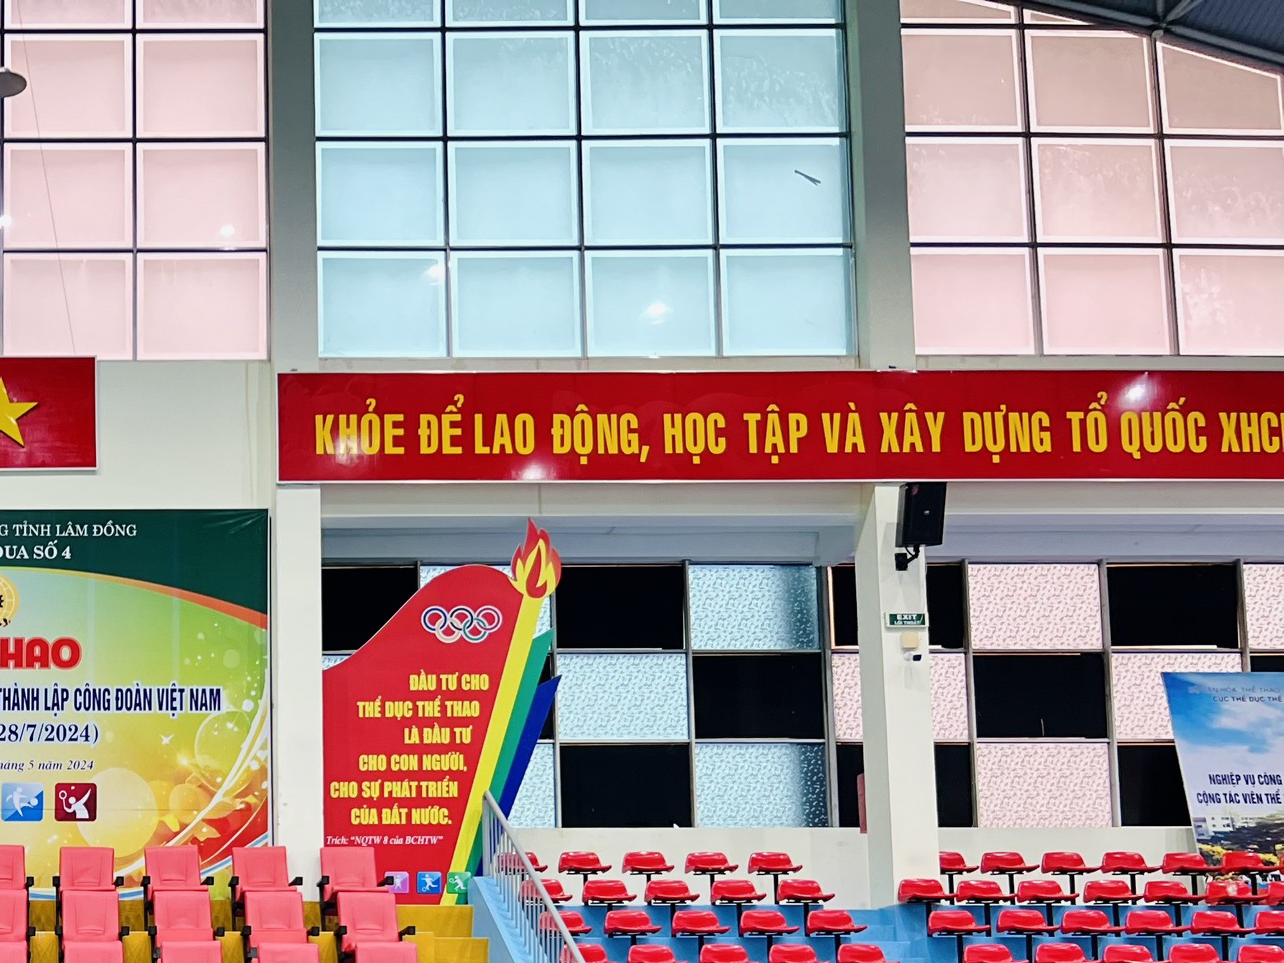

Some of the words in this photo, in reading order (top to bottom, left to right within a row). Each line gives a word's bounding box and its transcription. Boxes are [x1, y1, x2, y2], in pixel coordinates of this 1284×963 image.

[315, 398, 404, 455] KHỎE
[419, 394, 464, 454] ĐỂ
[475, 414, 535, 455] LAO
[552, 404, 649, 464] ĐỘNG,
[664, 413, 726, 464] HỌC
[744, 405, 808, 464] TẬP
[822, 403, 865, 453] VÀ
[881, 404, 945, 452] XÂY
[963, 405, 1051, 463] DỰNG
[1067, 392, 1107, 452] TỔ
[1121, 398, 1207, 458] QUỐC
[1220, 412, 1284, 452] XHC
[13, 521, 51, 536] TỈNH
[56, 522, 88, 536] LÂM
[93, 520, 136, 536] ĐỒNG
[34, 540, 57, 559] SỐ
[62, 546, 71, 559] 4
[410, 670, 436, 690] ĐẦU
[440, 672, 458, 690] TƯ
[462, 674, 489, 690] CHO
[45, 681, 69, 716] LẬP
[74, 681, 110, 711] CÔNG
[115, 681, 152, 711] ĐOÀN
[157, 681, 185, 716] VIỆT
[190, 689, 220, 711] NAM
[357, 696, 381, 717] THỂ
[385, 701, 412, 720] DỤC
[416, 696, 441, 717] THỂ
[445, 701, 480, 717] THAO
[404, 726, 420, 744] LÀ
[423, 723, 450, 744] ĐẦU
[454, 725, 472, 744] TƯ
[28, 759, 34, 770] 5
[38, 761, 63, 770] năm
[67, 759, 94, 770] 2024
[359, 755, 386, 771] CHO
[391, 754, 418, 771] CON
[423, 752, 467, 771] NGƯỜI,
[330, 782, 358, 798] CHO
[362, 779, 381, 800] SỰ
[384, 779, 418, 797] PHÁT
[420, 776, 458, 797] TRIỂN
[1209, 772, 1241, 787] NGHIỆP
[1243, 774, 1255, 787] VỤ
[1258, 772, 1282, 785] CÔNG
[1197, 791, 1221, 806] CỘNG
[1223, 791, 1240, 804] TÁC
[1242, 791, 1263, 804] VIÊN
[1265, 788, 1282, 804] THỂ
[351, 805, 378, 824] CỦA
[382, 803, 408, 824] ĐẤT
[412, 806, 452, 824] NƯỚC.
